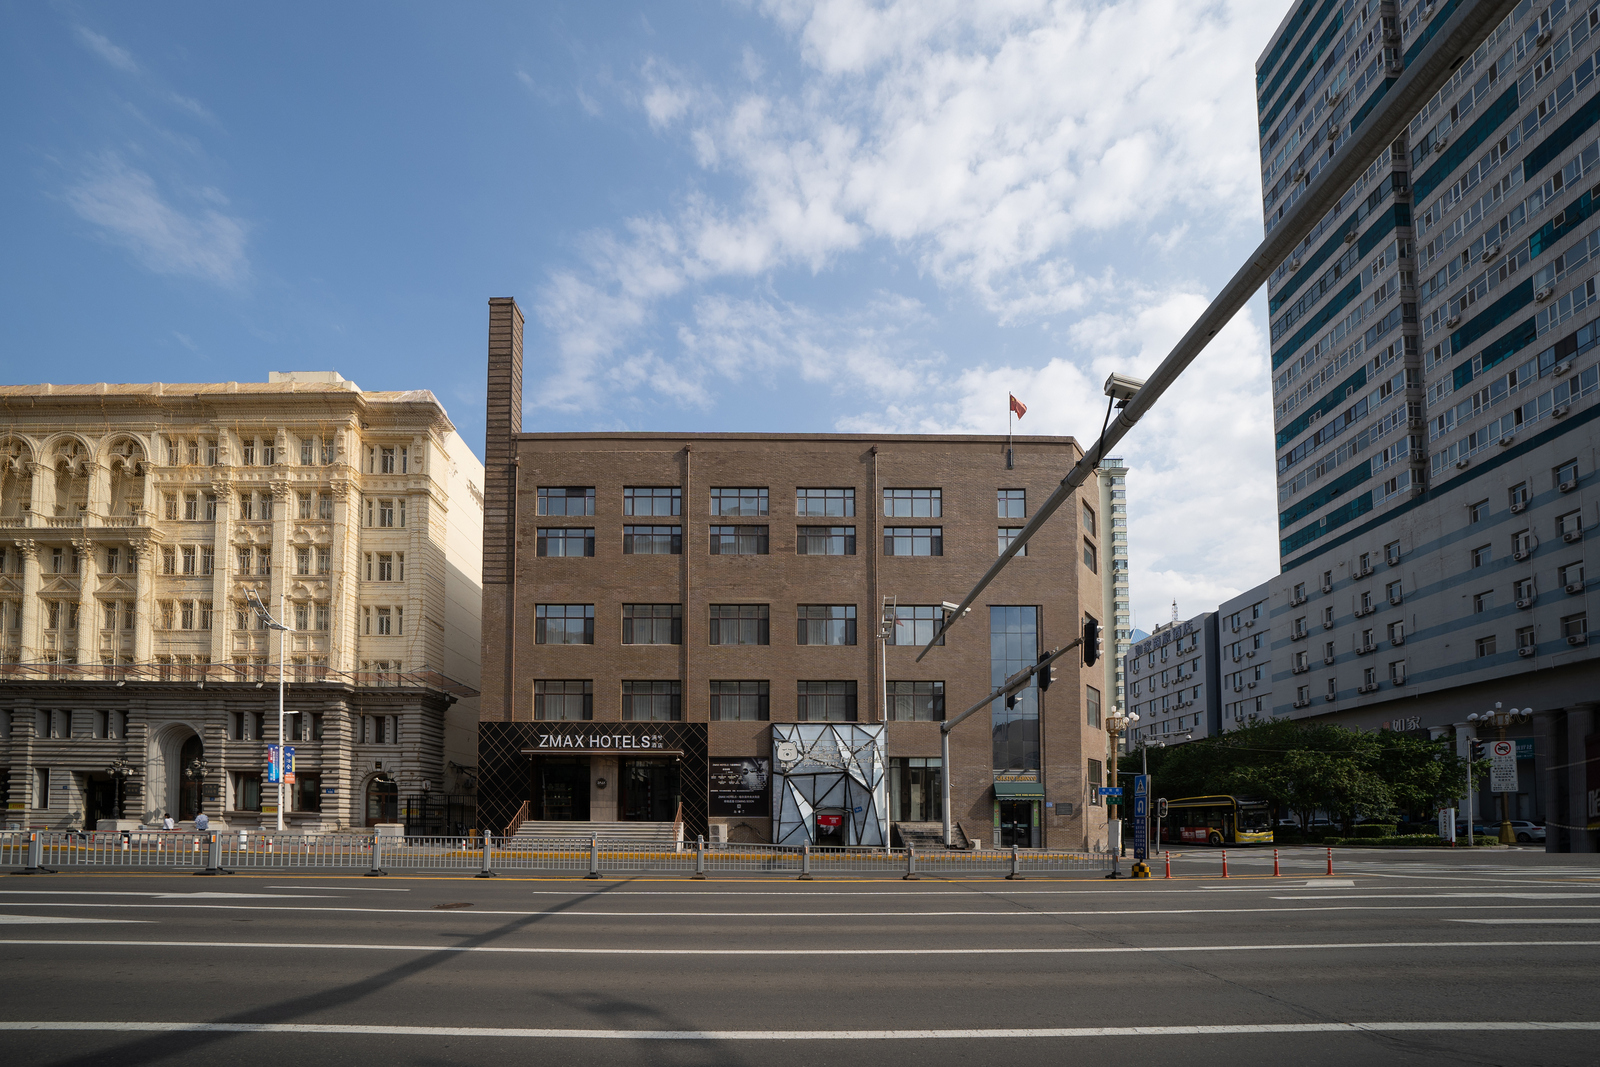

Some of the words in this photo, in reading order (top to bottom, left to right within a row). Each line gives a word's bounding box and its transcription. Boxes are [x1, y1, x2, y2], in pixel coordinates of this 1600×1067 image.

[1392, 715, 1420, 732] 如家
[539, 734, 584, 748] ZMAX
[589, 734, 651, 748] HOTELS
